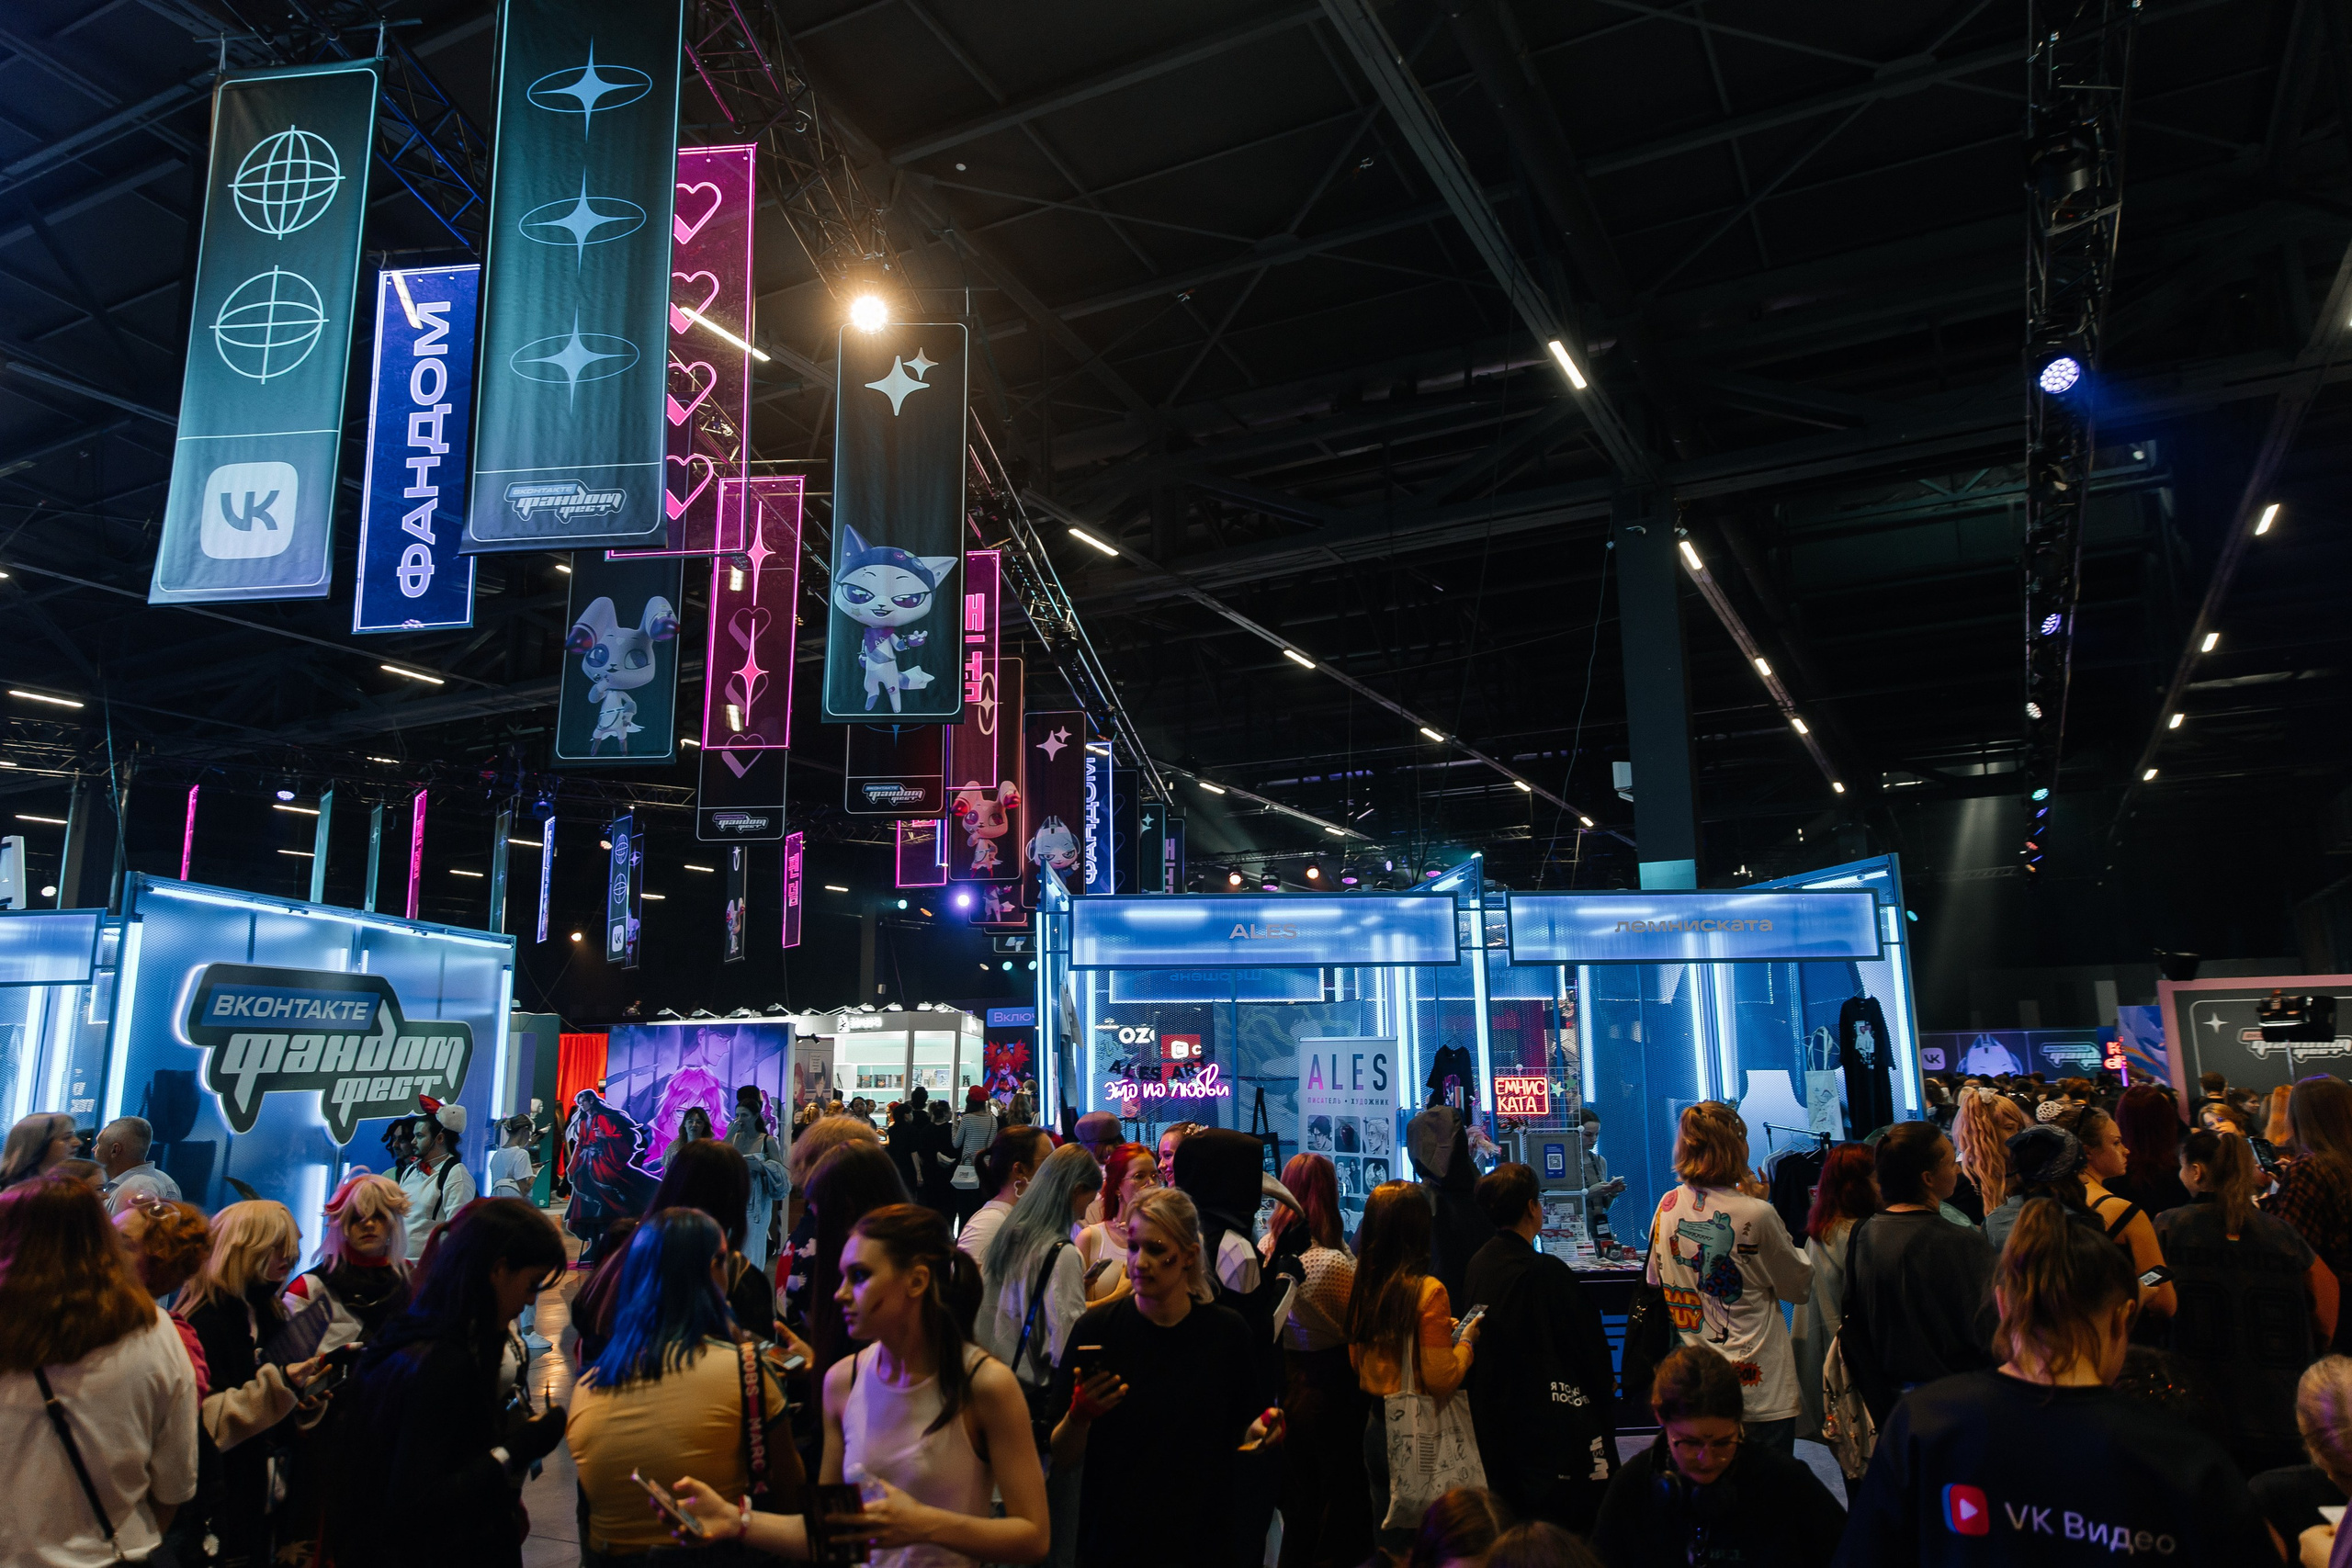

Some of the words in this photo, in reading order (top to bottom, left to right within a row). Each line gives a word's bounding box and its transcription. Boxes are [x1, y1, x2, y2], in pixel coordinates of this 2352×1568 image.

[397, 301, 452, 598] ФАНДОМ
[512, 486, 573, 495] ВКОНТАКТЕ
[220, 490, 280, 531] VK
[1086, 757, 1101, 885] ФАНДОМ
[1229, 924, 1296, 939] ALES
[1614, 919, 1773, 933] лемниската
[212, 995, 369, 1021] ВКОНТАКТЕ
[994, 1011, 1035, 1022] Вклю
[1108, 1059, 1161, 1080] ALES
[1924, 1054, 1941, 1064] VK
[1104, 1079, 1138, 1102] это
[1142, 1082, 1166, 1099] по
[1170, 1063, 1229, 1099] любви
[1307, 1054, 1387, 1091] ALES
[1307, 1097, 1341, 1105] ПИСАТЕЛЬ
[1351, 1098, 1389, 1106] ХУДОЖНИК
[1498, 1096, 1537, 1112] КАТА
[749, 1416, 765, 1470] MARC
[2005, 1502, 2053, 1535] VK
[2064, 1511, 2176, 1555] Видео
